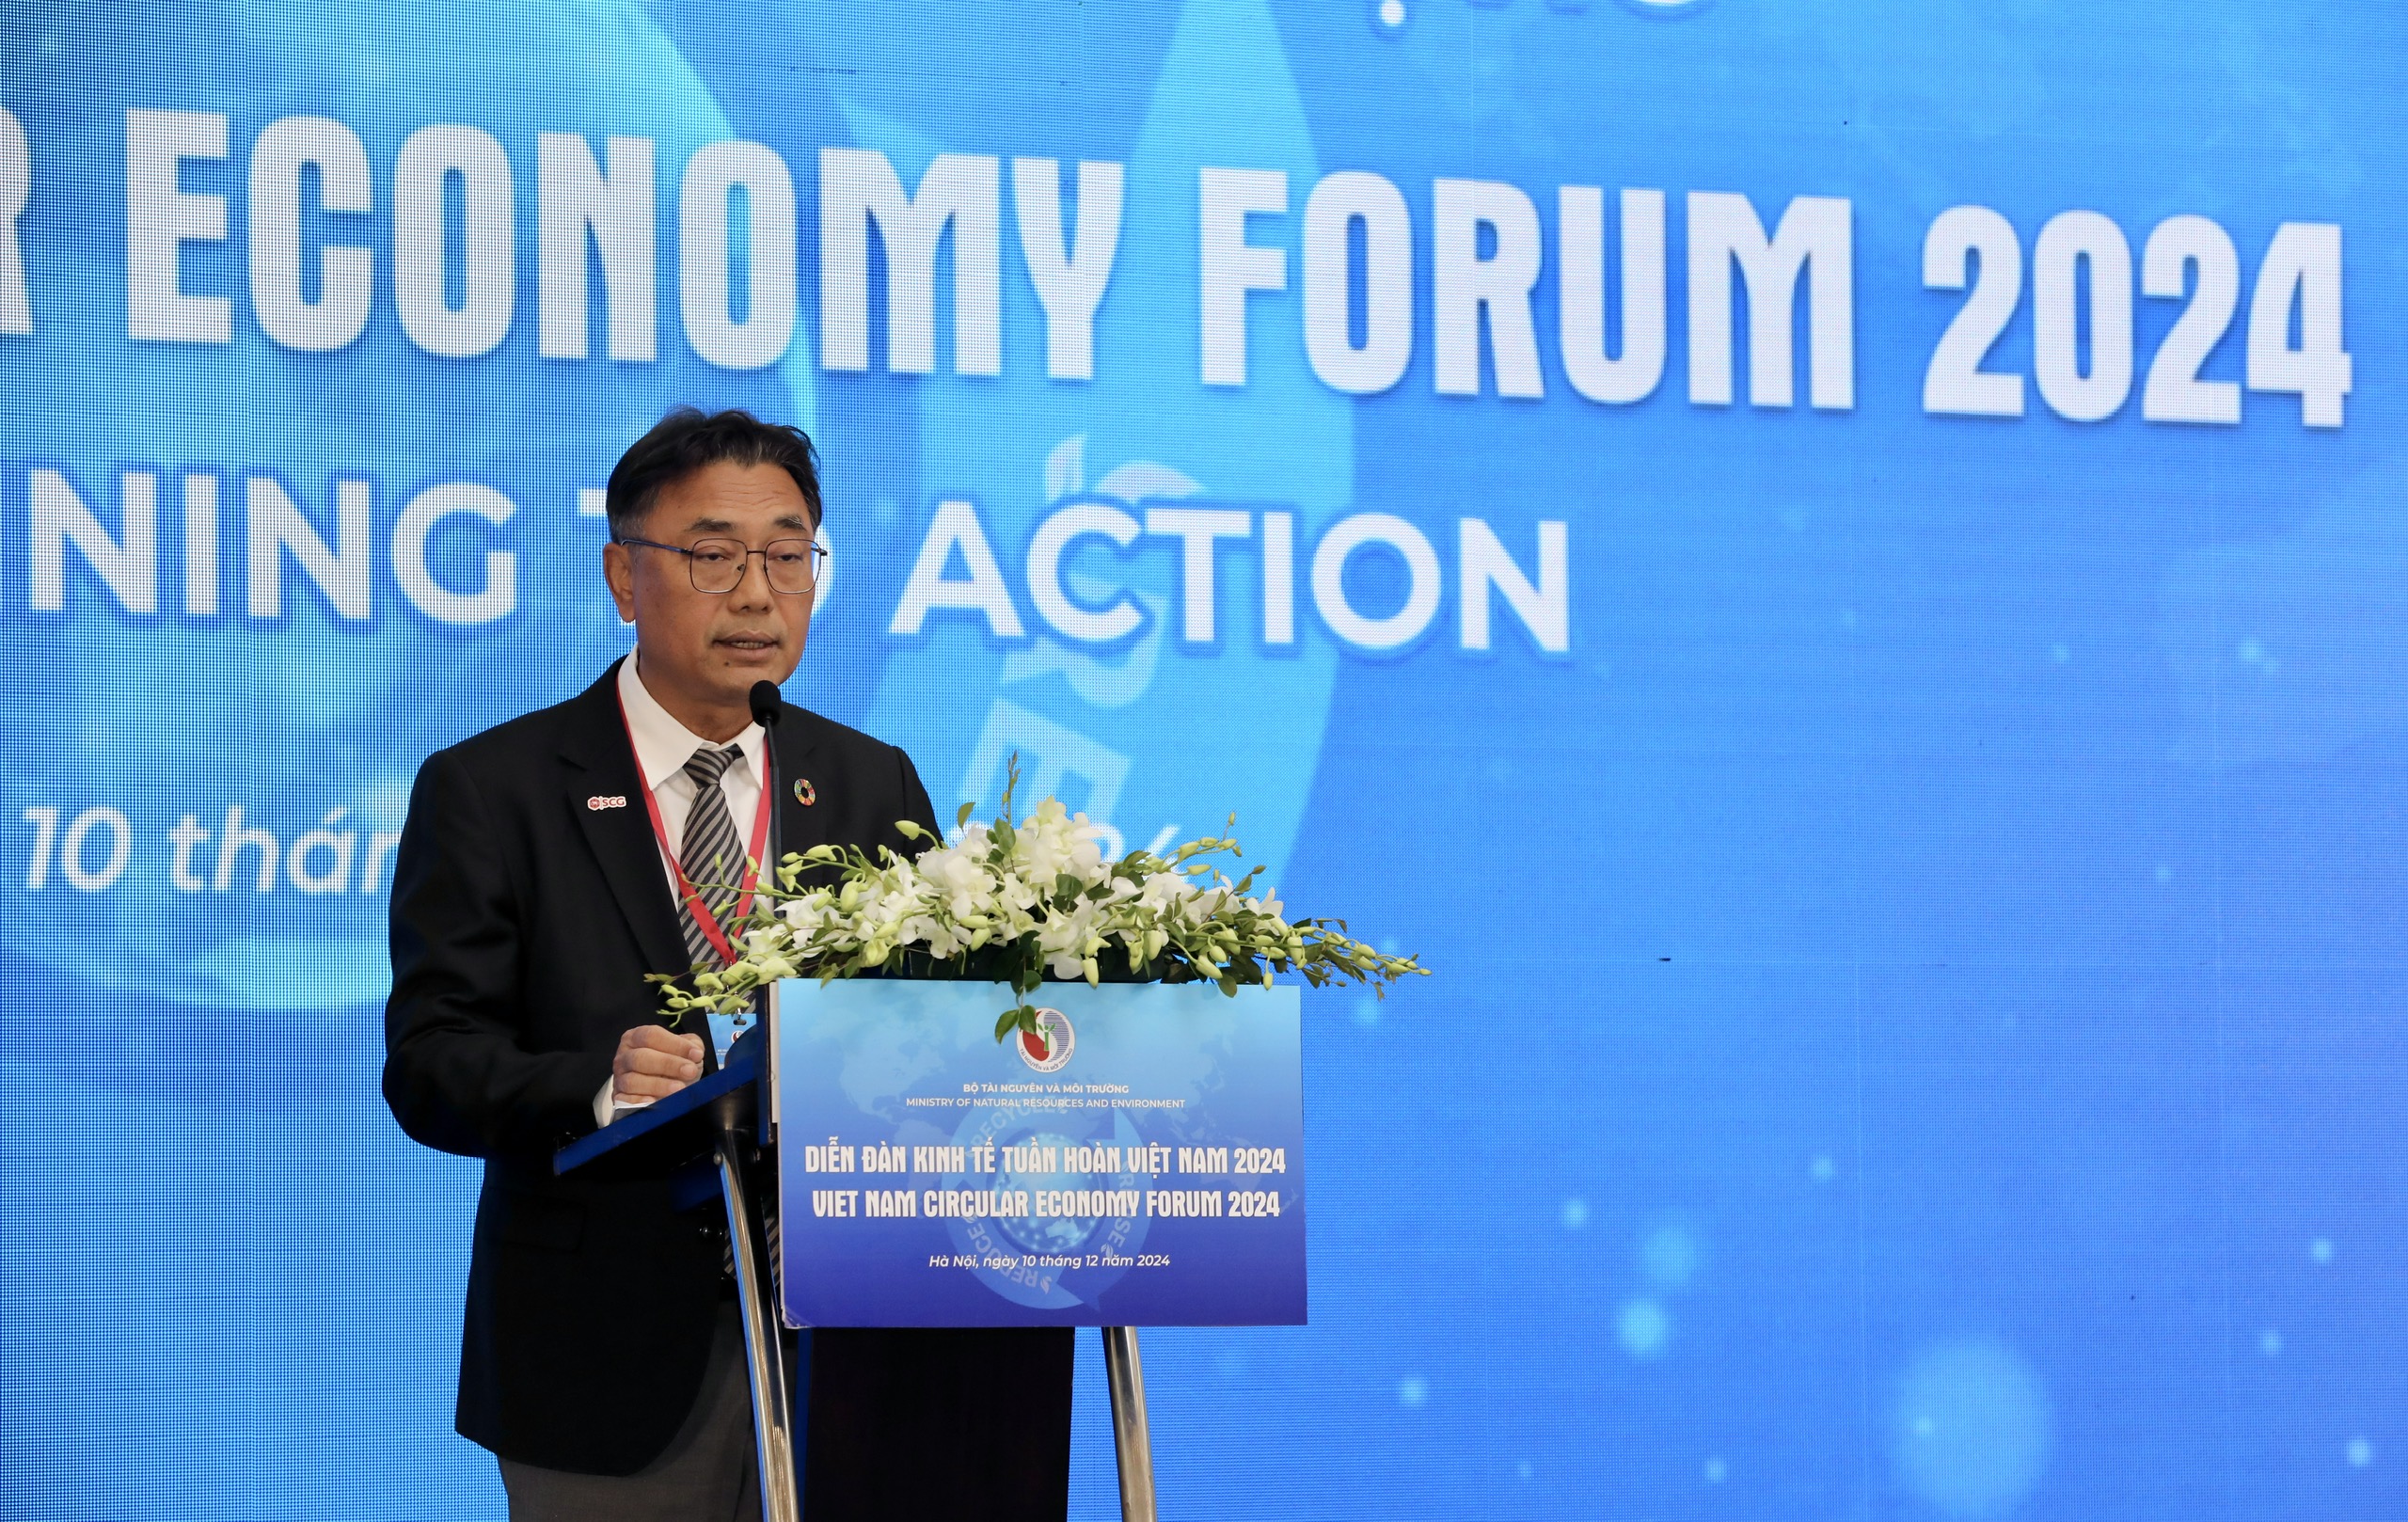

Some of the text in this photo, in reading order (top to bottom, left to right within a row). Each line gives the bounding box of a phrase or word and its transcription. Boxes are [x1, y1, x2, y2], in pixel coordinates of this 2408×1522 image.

[126, 107, 1124, 381] ECONOMY
[1198, 166, 1854, 410] FORUM
[1922, 204, 2353, 428] 2024
[889, 499, 1569, 653] ACTION
[602, 798, 625, 807] SCG
[22, 805, 132, 893] 10
[963, 1082, 1130, 1095] BỘ TÀI NGUYÊN VÀ MÔI TRƯỜNG
[906, 1098, 1186, 1108] MINISTRY OF NATURAL RESOURCES AND ENVIRONMENT
[805, 1135, 1286, 1179] DIỄN ĐÀN KINH TẾ TUẦN HOÀN VIỆT NAM 2024
[812, 1190, 1280, 1217] VIET NAM CIRCULAR ECONOMY FORUM 2024
[928, 1254, 1171, 1270] Hà Nội, ngày 10 tháng 12 năm 2024
